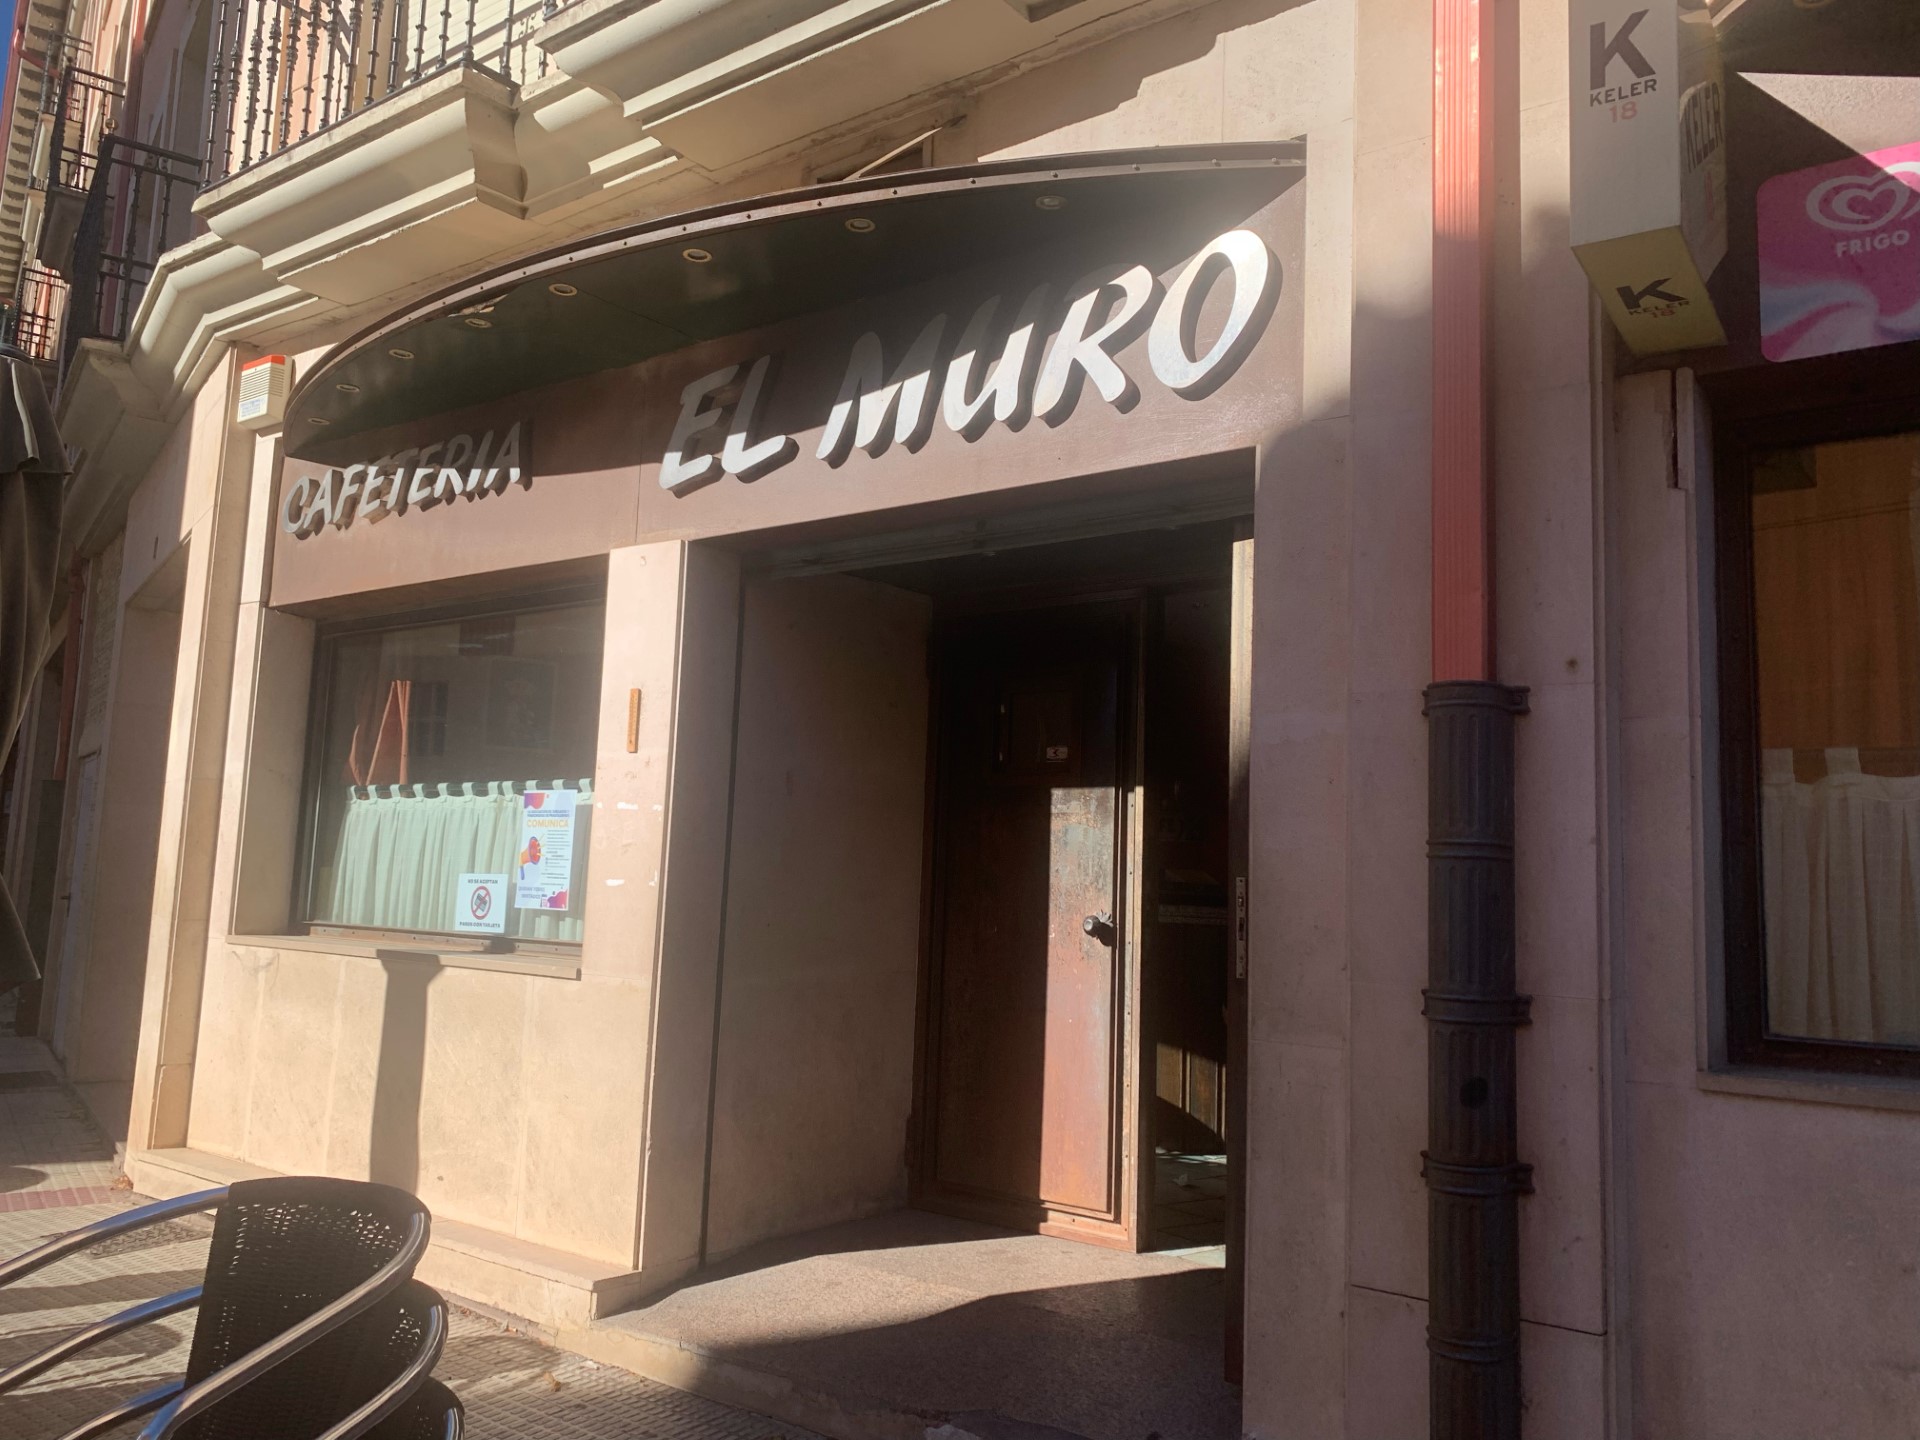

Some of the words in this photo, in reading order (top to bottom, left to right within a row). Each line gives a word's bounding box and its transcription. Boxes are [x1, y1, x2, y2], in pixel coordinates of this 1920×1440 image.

[1589, 8, 1656, 91] K
[1589, 78, 1658, 108] KELER
[1608, 100, 1638, 123] 18
[1836, 229, 1910, 258] FRIGO
[1616, 277, 1690, 310] K
[1628, 300, 1691, 316] KELER
[282, 421, 525, 536] CAFETERIA
[658, 355, 792, 492] EL
[815, 229, 1275, 464] MURO
